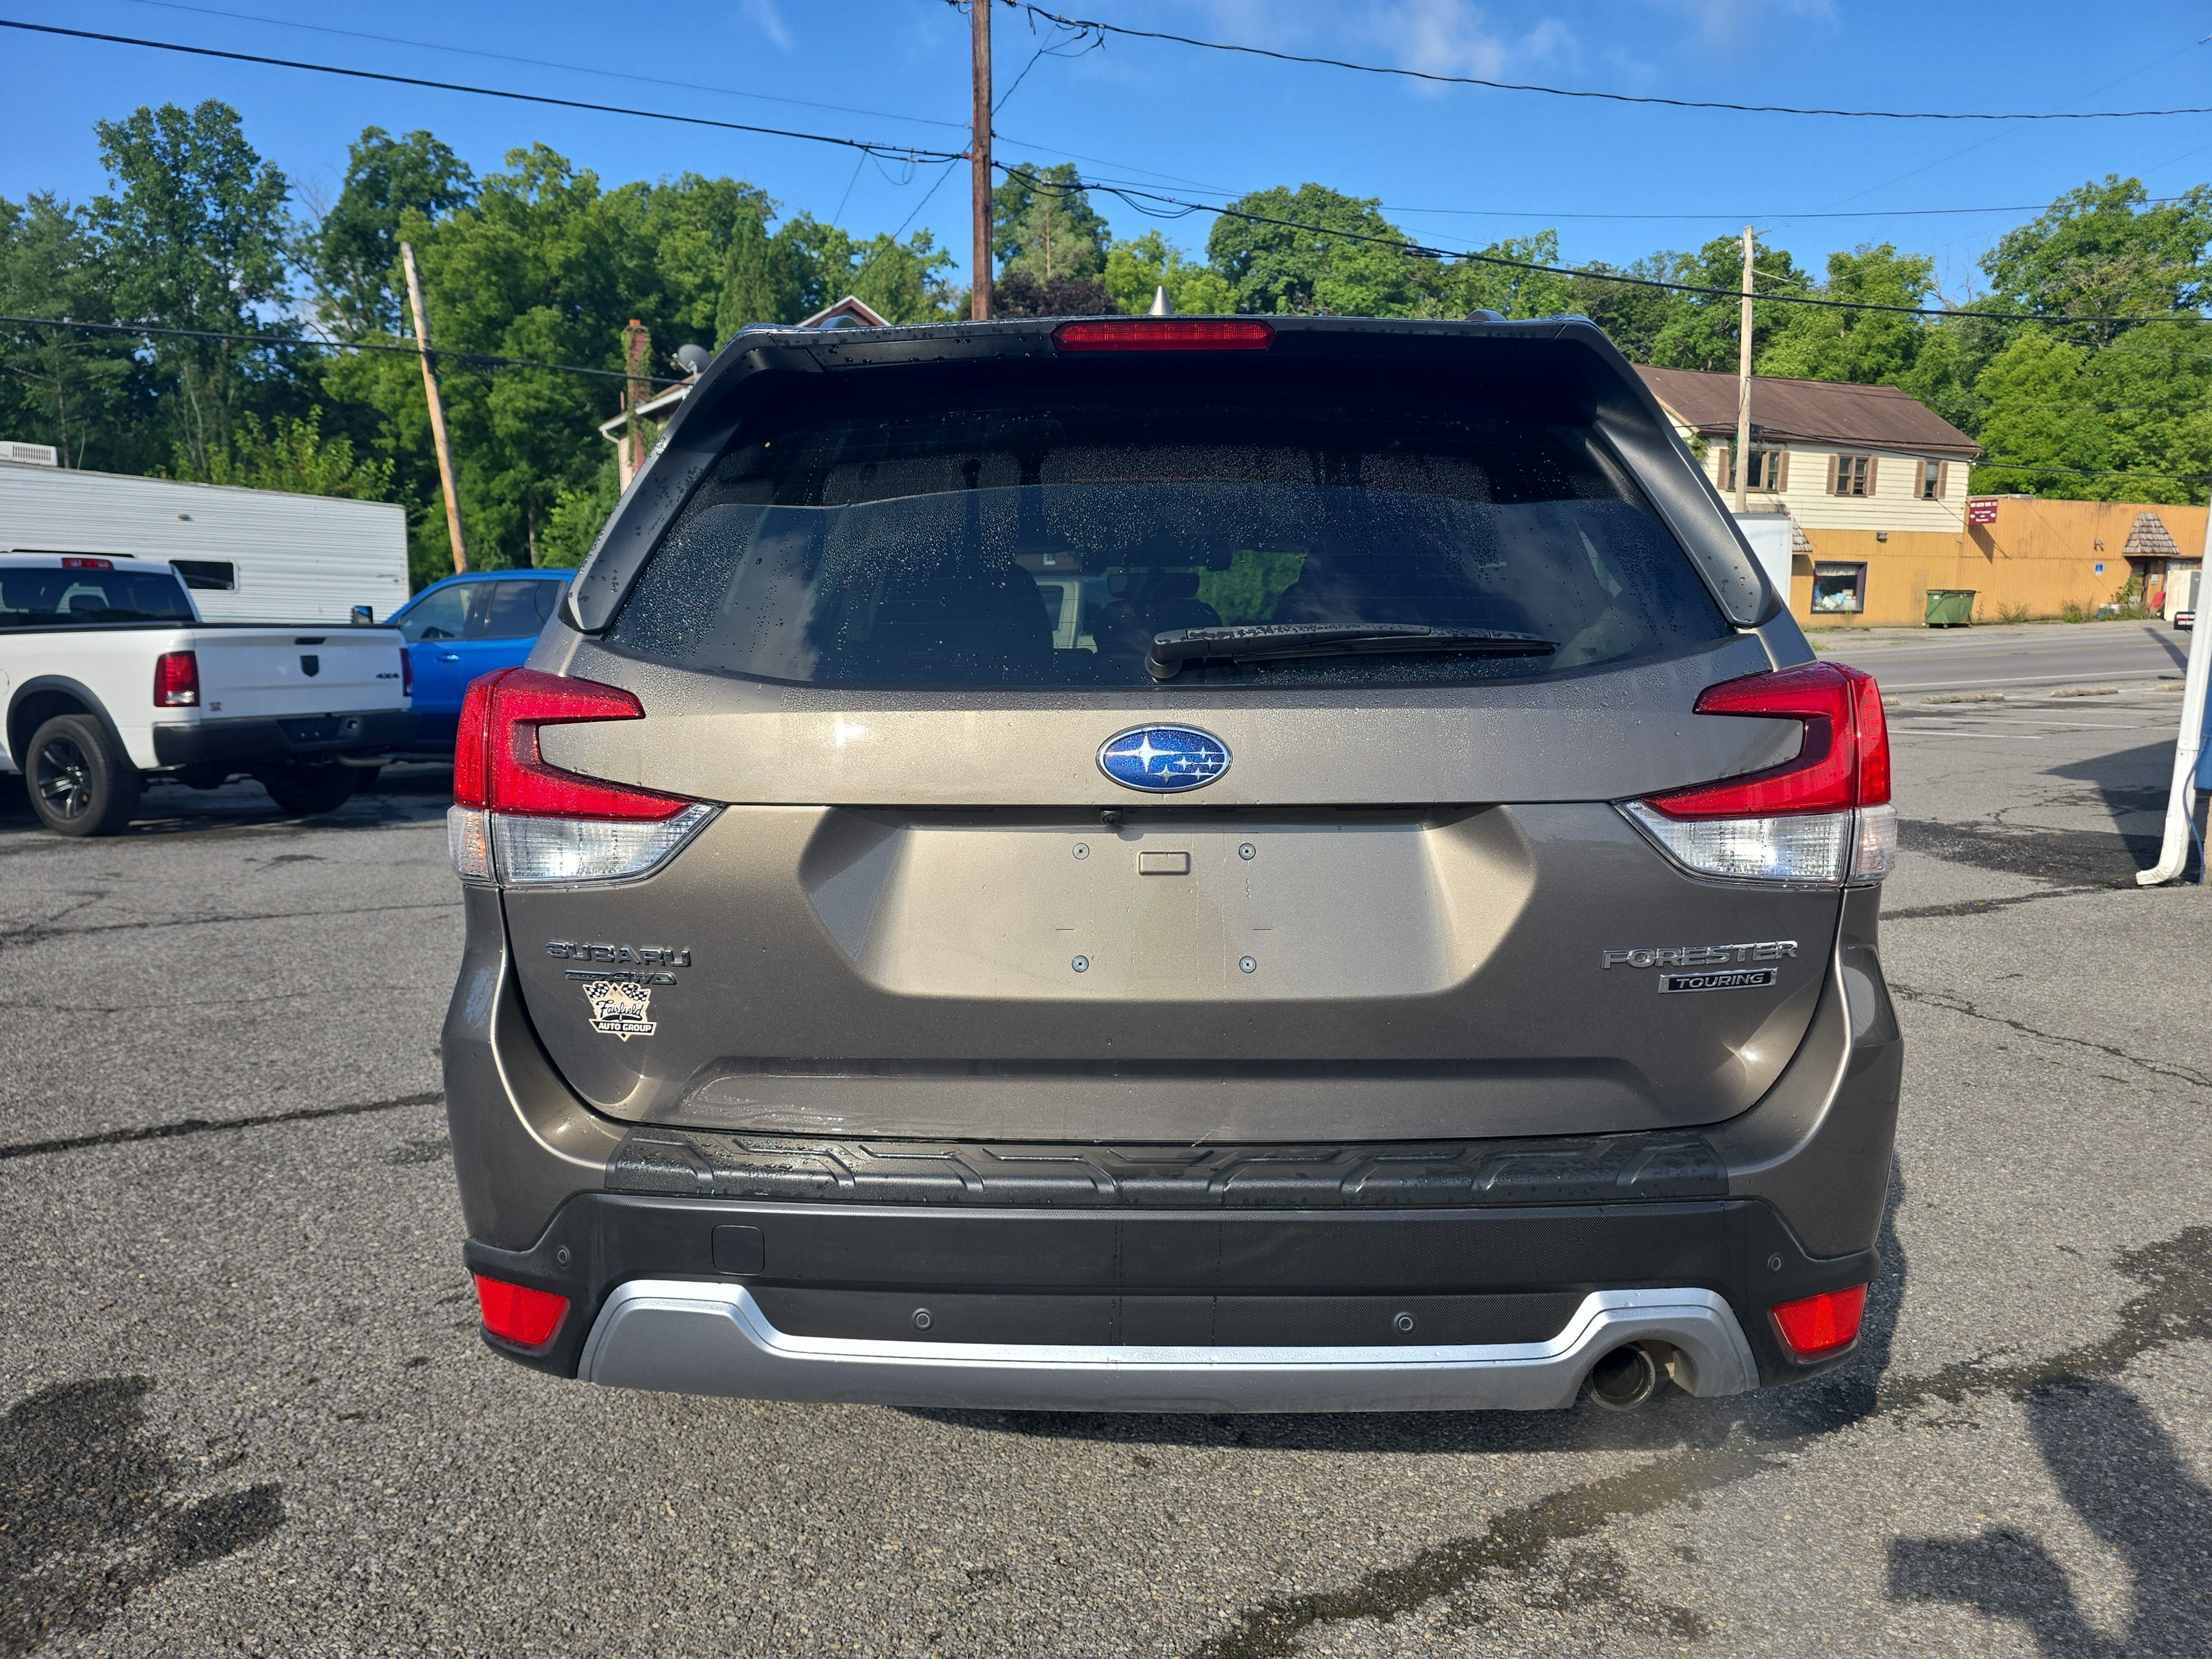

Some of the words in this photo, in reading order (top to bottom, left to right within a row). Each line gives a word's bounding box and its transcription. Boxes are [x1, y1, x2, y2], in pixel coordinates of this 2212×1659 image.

[545, 941, 691, 967] SUBARU
[1600, 940, 1798, 969] FORESTER
[601, 970, 677, 985] AWD
[1676, 973, 1765, 989] TOURING
[596, 999, 644, 1018] Fairfield
[598, 1022, 621, 1030] AUTO
[622, 1023, 652, 1032] GROUP
